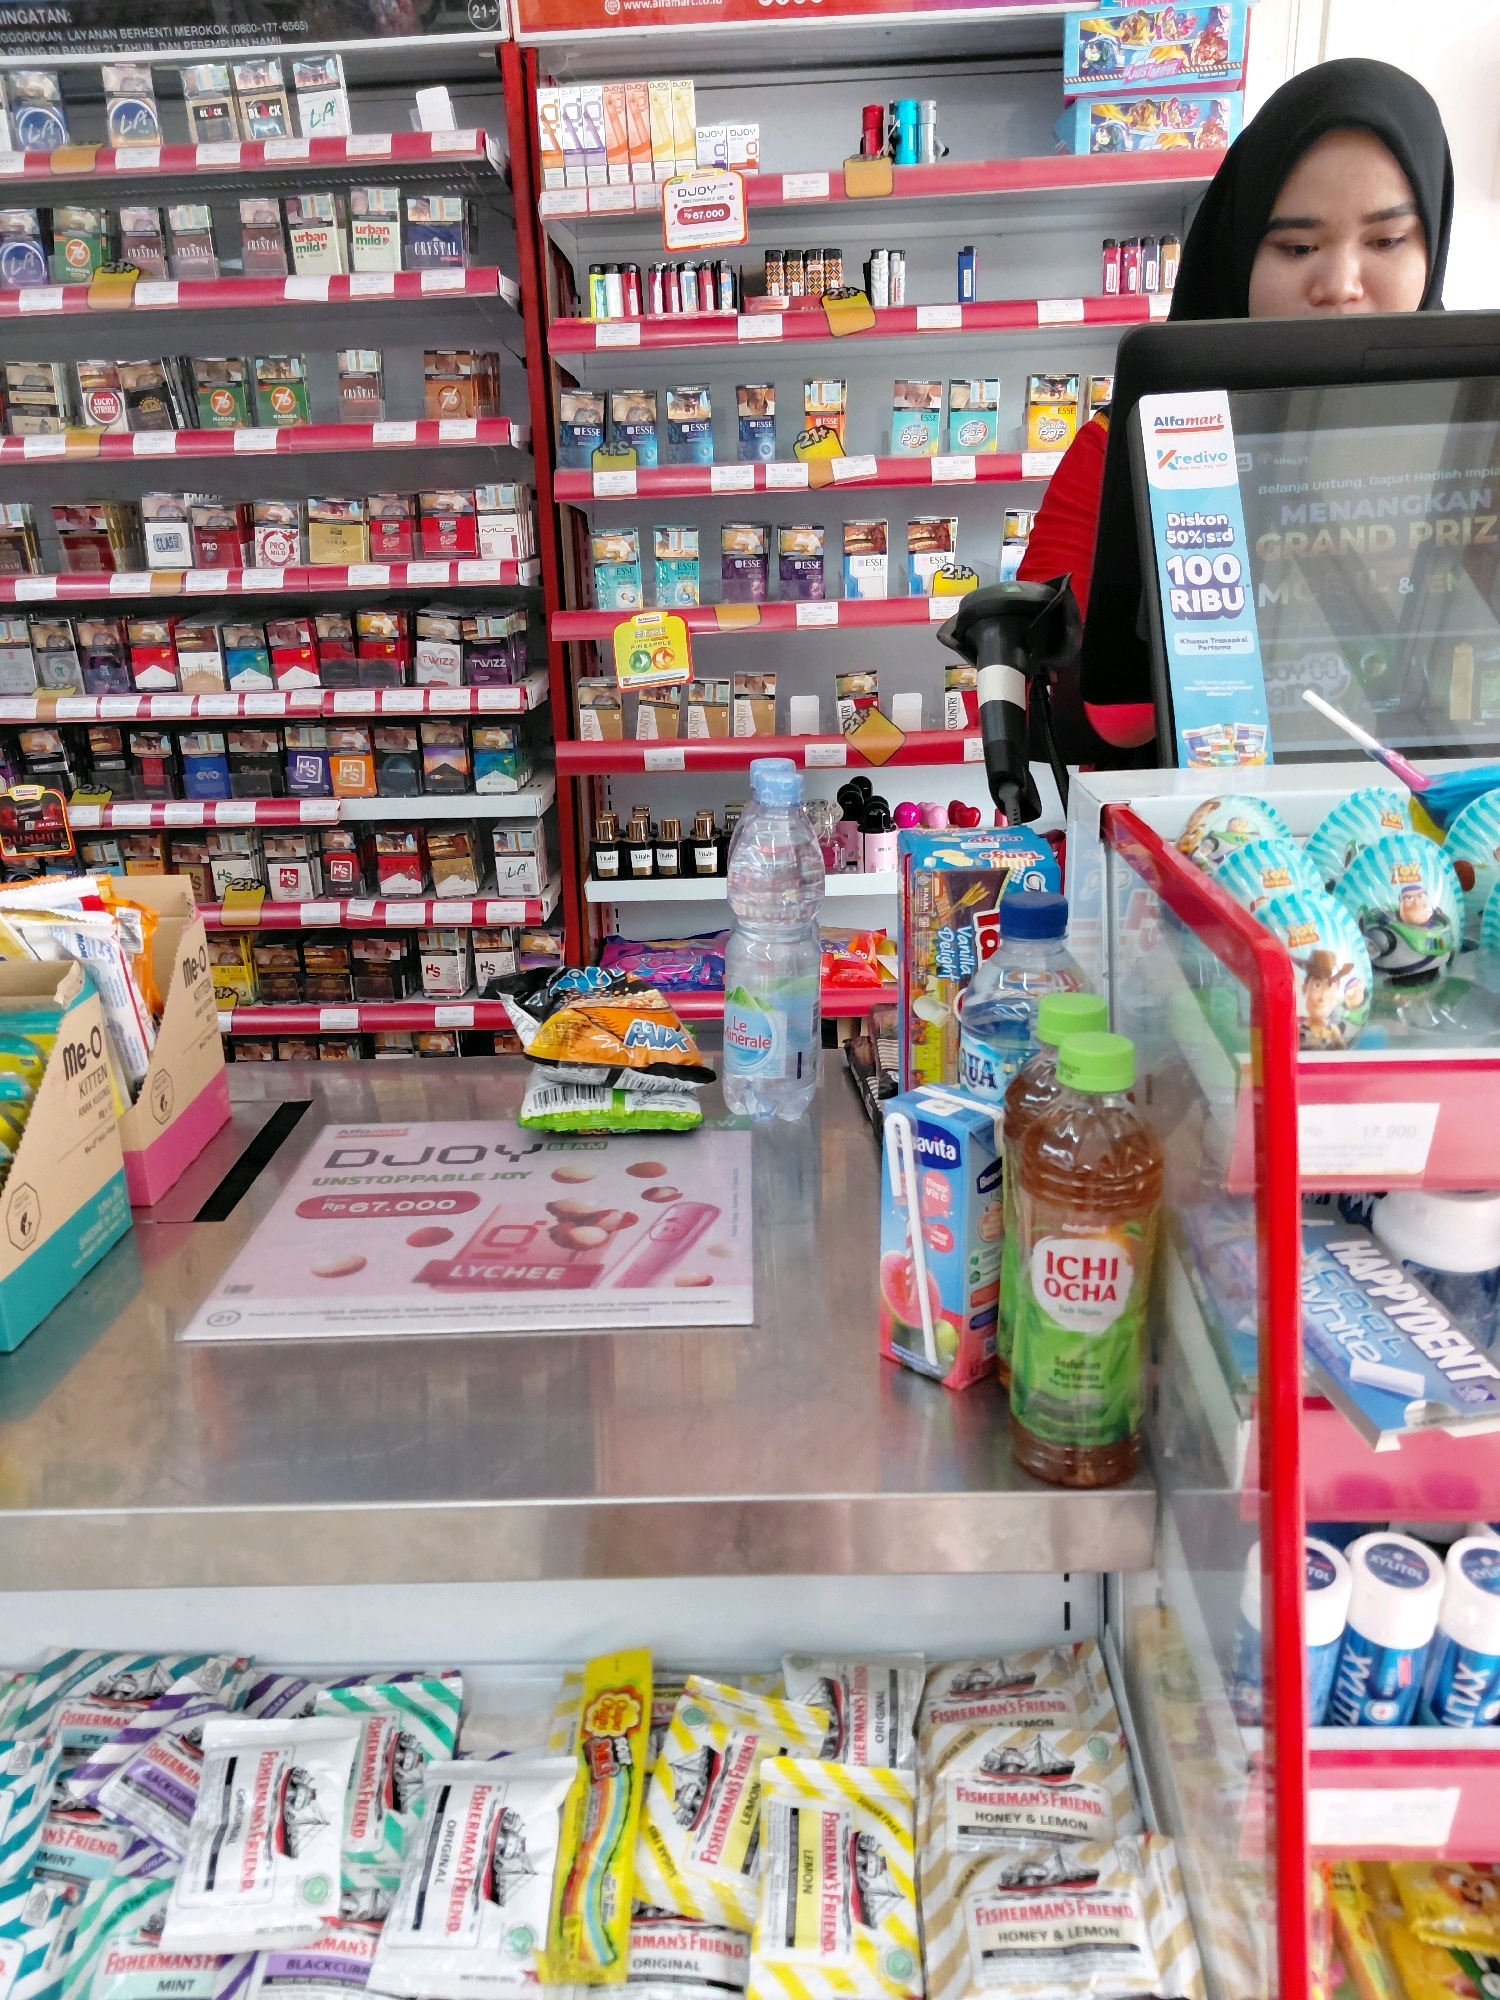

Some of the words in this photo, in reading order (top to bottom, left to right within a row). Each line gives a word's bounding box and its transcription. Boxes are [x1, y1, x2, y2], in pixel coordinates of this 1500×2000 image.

[471, 4, 498, 19] 21+
[68, 29, 117, 41] LAYANAN
[120, 27, 172, 39] BERHENTI
[175, 24, 229, 37] MEROKOK
[698, 130, 724, 139] DJOY
[730, 128, 756, 137] DJOY
[677, 185, 718, 198] DJOY
[294, 231, 328, 244] urban
[355, 224, 391, 236] urban
[355, 234, 382, 246] mild
[414, 240, 460, 256] CRYSTAL
[296, 243, 321, 254] mild
[93, 397, 114, 407] LUCKY
[93, 405, 117, 415] STRIKE
[921, 413, 938, 422] ESSE
[1057, 406, 1077, 415] ESSE
[690, 422, 710, 433] ESSE
[756, 420, 774, 429] ESSE
[822, 416, 838, 426] ESSE
[1153, 413, 1225, 428] Alfamart
[581, 427, 601, 437] ESSE
[635, 425, 655, 435] ESSE
[798, 428, 829, 448] 21+
[961, 427, 984, 438] POP
[1038, 428, 1066, 440] POP
[901, 434, 928, 446] POP
[1157, 450, 1229, 470] Kredivo
[1258, 482, 1309, 495] Belanja
[1369, 474, 1411, 487] Dapat
[1414, 469, 1462, 482] Hadiah
[1281, 488, 1492, 526] MENANGKAN
[1167, 512, 1229, 528] Diskon
[1166, 529, 1203, 545] 50%
[1206, 528, 1235, 544] s.d
[1255, 524, 1397, 563] GRAND
[202, 542, 218, 551] PRO
[270, 541, 286, 550] PRO
[677, 562, 697, 571] ESSE
[742, 558, 763, 569] ESSE
[801, 560, 822, 571] ESSE
[865, 558, 885, 568] ESSE
[929, 555, 949, 565] ESSE
[616, 566, 635, 576] ESSE
[941, 562, 974, 581] 21+
[1166, 553, 1242, 586] 100
[1399, 576, 1414, 594] &
[1170, 586, 1245, 613] RIBU
[630, 639, 673, 651] PINEAPPLE
[1210, 635, 1249, 644] Transaksi
[421, 654, 455, 667] TWIZZ
[471, 657, 507, 669] TWIZZ
[736, 703, 747, 737] COUNTRY
[947, 696, 958, 729] COUNTRY
[843, 708, 871, 736] 21+
[196, 770, 220, 781] evo
[79, 783, 109, 795] 21+
[1381, 809, 1403, 824] TOY
[2, 831, 66, 845] DUNHILL
[979, 849, 1046, 861] Tango
[1262, 867, 1290, 881] TOY
[1392, 862, 1420, 877] TOY
[231, 878, 261, 891] 21+
[1288, 922, 1316, 938] TOY
[935, 926, 960, 982] Delight
[956, 925, 976, 976] Vanilla
[733, 1015, 747, 1033] Le
[78, 1062, 108, 1100] KITTEN
[1360, 1124, 1418, 1140] 17.900
[322, 1142, 545, 1170] DJOY
[552, 1143, 606, 1151] BEAM
[310, 1172, 486, 1187] UNSTOPPABLE
[488, 1170, 535, 1182] JOY
[449, 1264, 567, 1282] LYCHEE
[1046, 1250, 1119, 1281] ICHI
[1043, 1277, 1117, 1303] OCHA
[1325, 1240, 1500, 1382] HAPPYDENT
[1369, 1553, 1426, 1582] XYLITOL
[875, 1690, 886, 1744] ORIGINAL
[930, 1699, 1017, 1724] FISHERMAN'S
[1017, 1697, 1068, 1713] FRIEND
[700, 1780, 744, 1866] FISHERMAN'S
[729, 1734, 760, 1780] FRIEND
[740, 1781, 762, 1826] LEMON
[956, 1786, 1050, 1807] FISHERMAN'S
[1050, 1789, 1106, 1818] FRIEND
[975, 1811, 1022, 1824] HONEY
[1026, 1813, 1036, 1824] &
[1039, 1814, 1089, 1832] LEMON
[457, 1784, 493, 1878] FISHERMAN'S
[64, 1827, 120, 1857] FRIEND
[433, 1819, 457, 1886] ORIGINAL
[821, 1810, 845, 1892] FISHERMAN'S
[240, 1832, 266, 1893] FRIEND
[802, 1848, 815, 1895] LEMON
[446, 1876, 476, 1935] FRIEND
[975, 1899, 1075, 1927] FISHERMAN'S
[1076, 1897, 1139, 1919] FRIEND
[820, 1889, 844, 1957] FRIEND
[998, 1930, 1048, 1944] HONEY
[1052, 1929, 1065, 1941] &
[1067, 1926, 1121, 1939] LEMON
[689, 1932, 745, 1959] FRIEND
[105, 1953, 201, 1975] FISHERMAN'S
[632, 1957, 702, 1972] ORIGINAL
[156, 1978, 196, 1993] MINT
